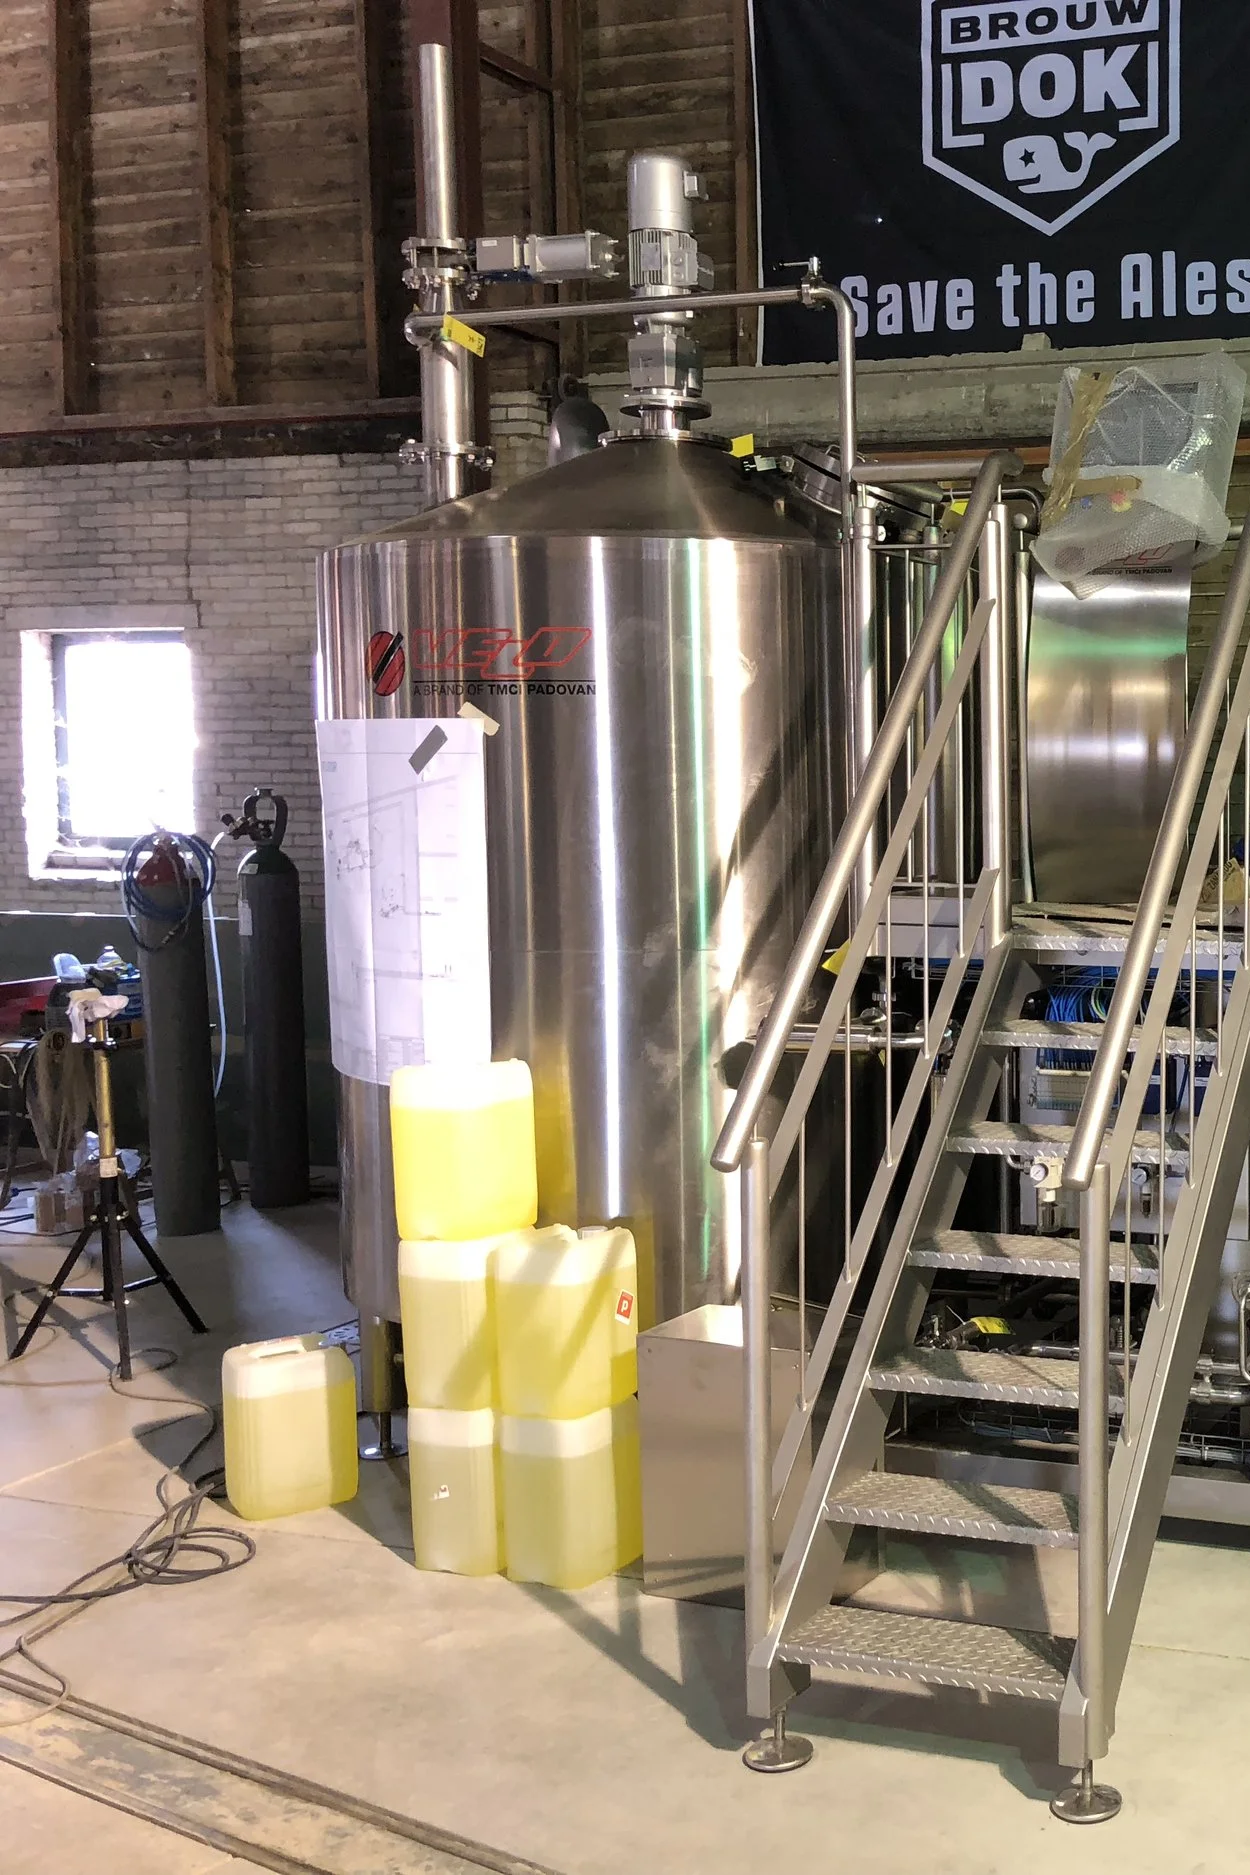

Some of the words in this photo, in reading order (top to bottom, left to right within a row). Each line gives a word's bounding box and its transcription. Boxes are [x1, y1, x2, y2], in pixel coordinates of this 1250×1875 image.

[950, 0, 1149, 45] BROUW
[960, 43, 1141, 125] DOK
[840, 274, 975, 338] Save
[996, 261, 1095, 327] the
[413, 685, 422, 696] A
[424, 684, 464, 696] BRAND
[467, 684, 483, 696] OF
[488, 684, 521, 696] TMCI
[527, 683, 596, 696] PADOVAN
